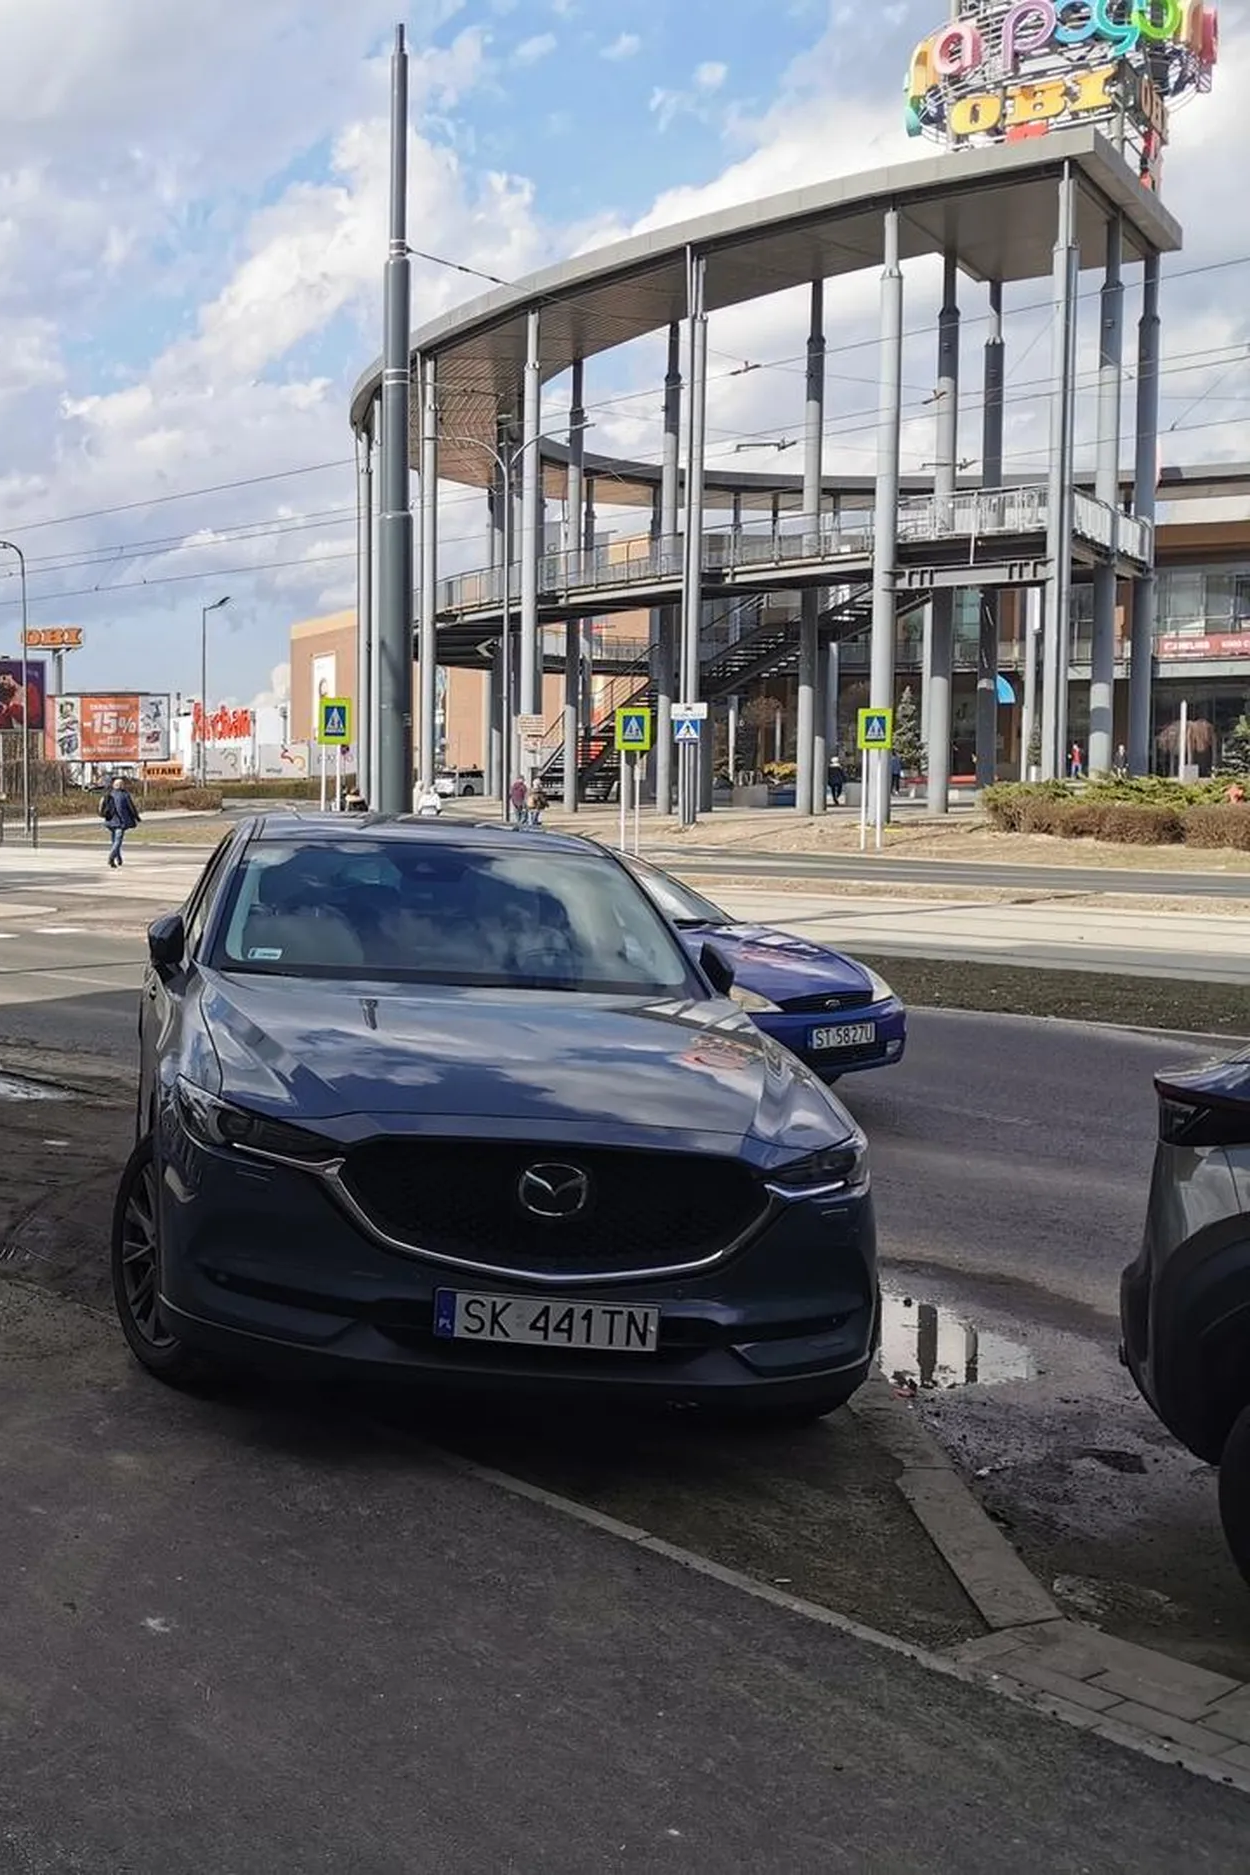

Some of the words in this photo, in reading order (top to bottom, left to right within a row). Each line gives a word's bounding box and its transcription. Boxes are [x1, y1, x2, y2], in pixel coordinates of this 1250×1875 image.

[951, 66, 1118, 135] OBI
[20, 628, 82, 646] OBI
[815, 1029, 831, 1047] ST
[463, 1299, 513, 1338] SK
[529, 1305, 650, 1347] 441TN
